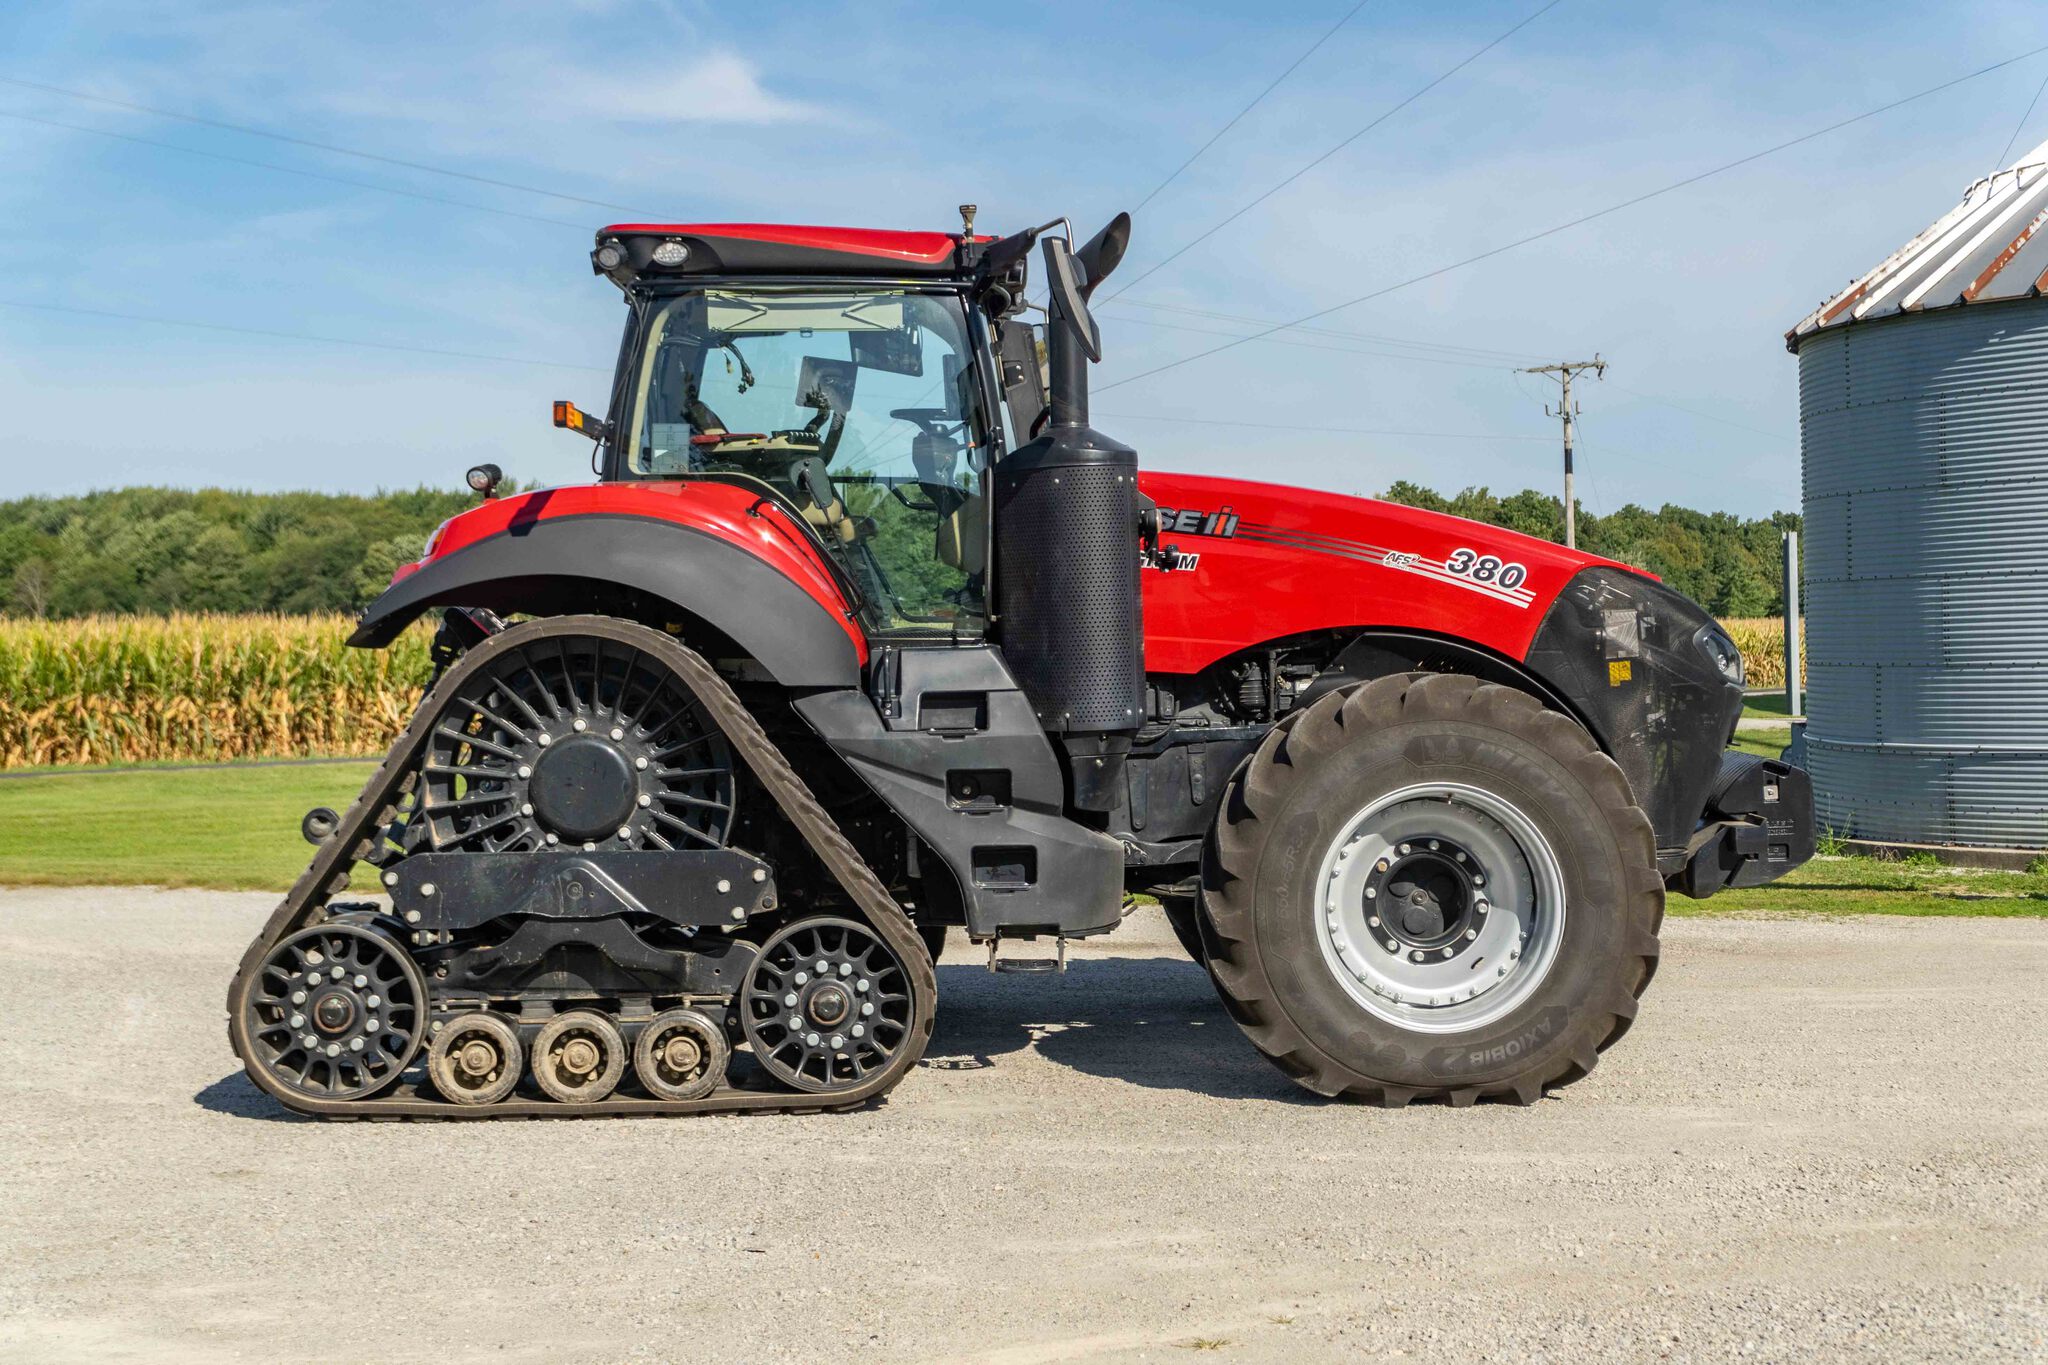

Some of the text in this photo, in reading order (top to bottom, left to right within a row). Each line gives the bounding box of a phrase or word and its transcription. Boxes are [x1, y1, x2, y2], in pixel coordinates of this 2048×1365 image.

[1385, 552, 1412, 565] AFS
[1446, 548, 1526, 590] 380
[1470, 1016, 1552, 1066] AXIOBIB
